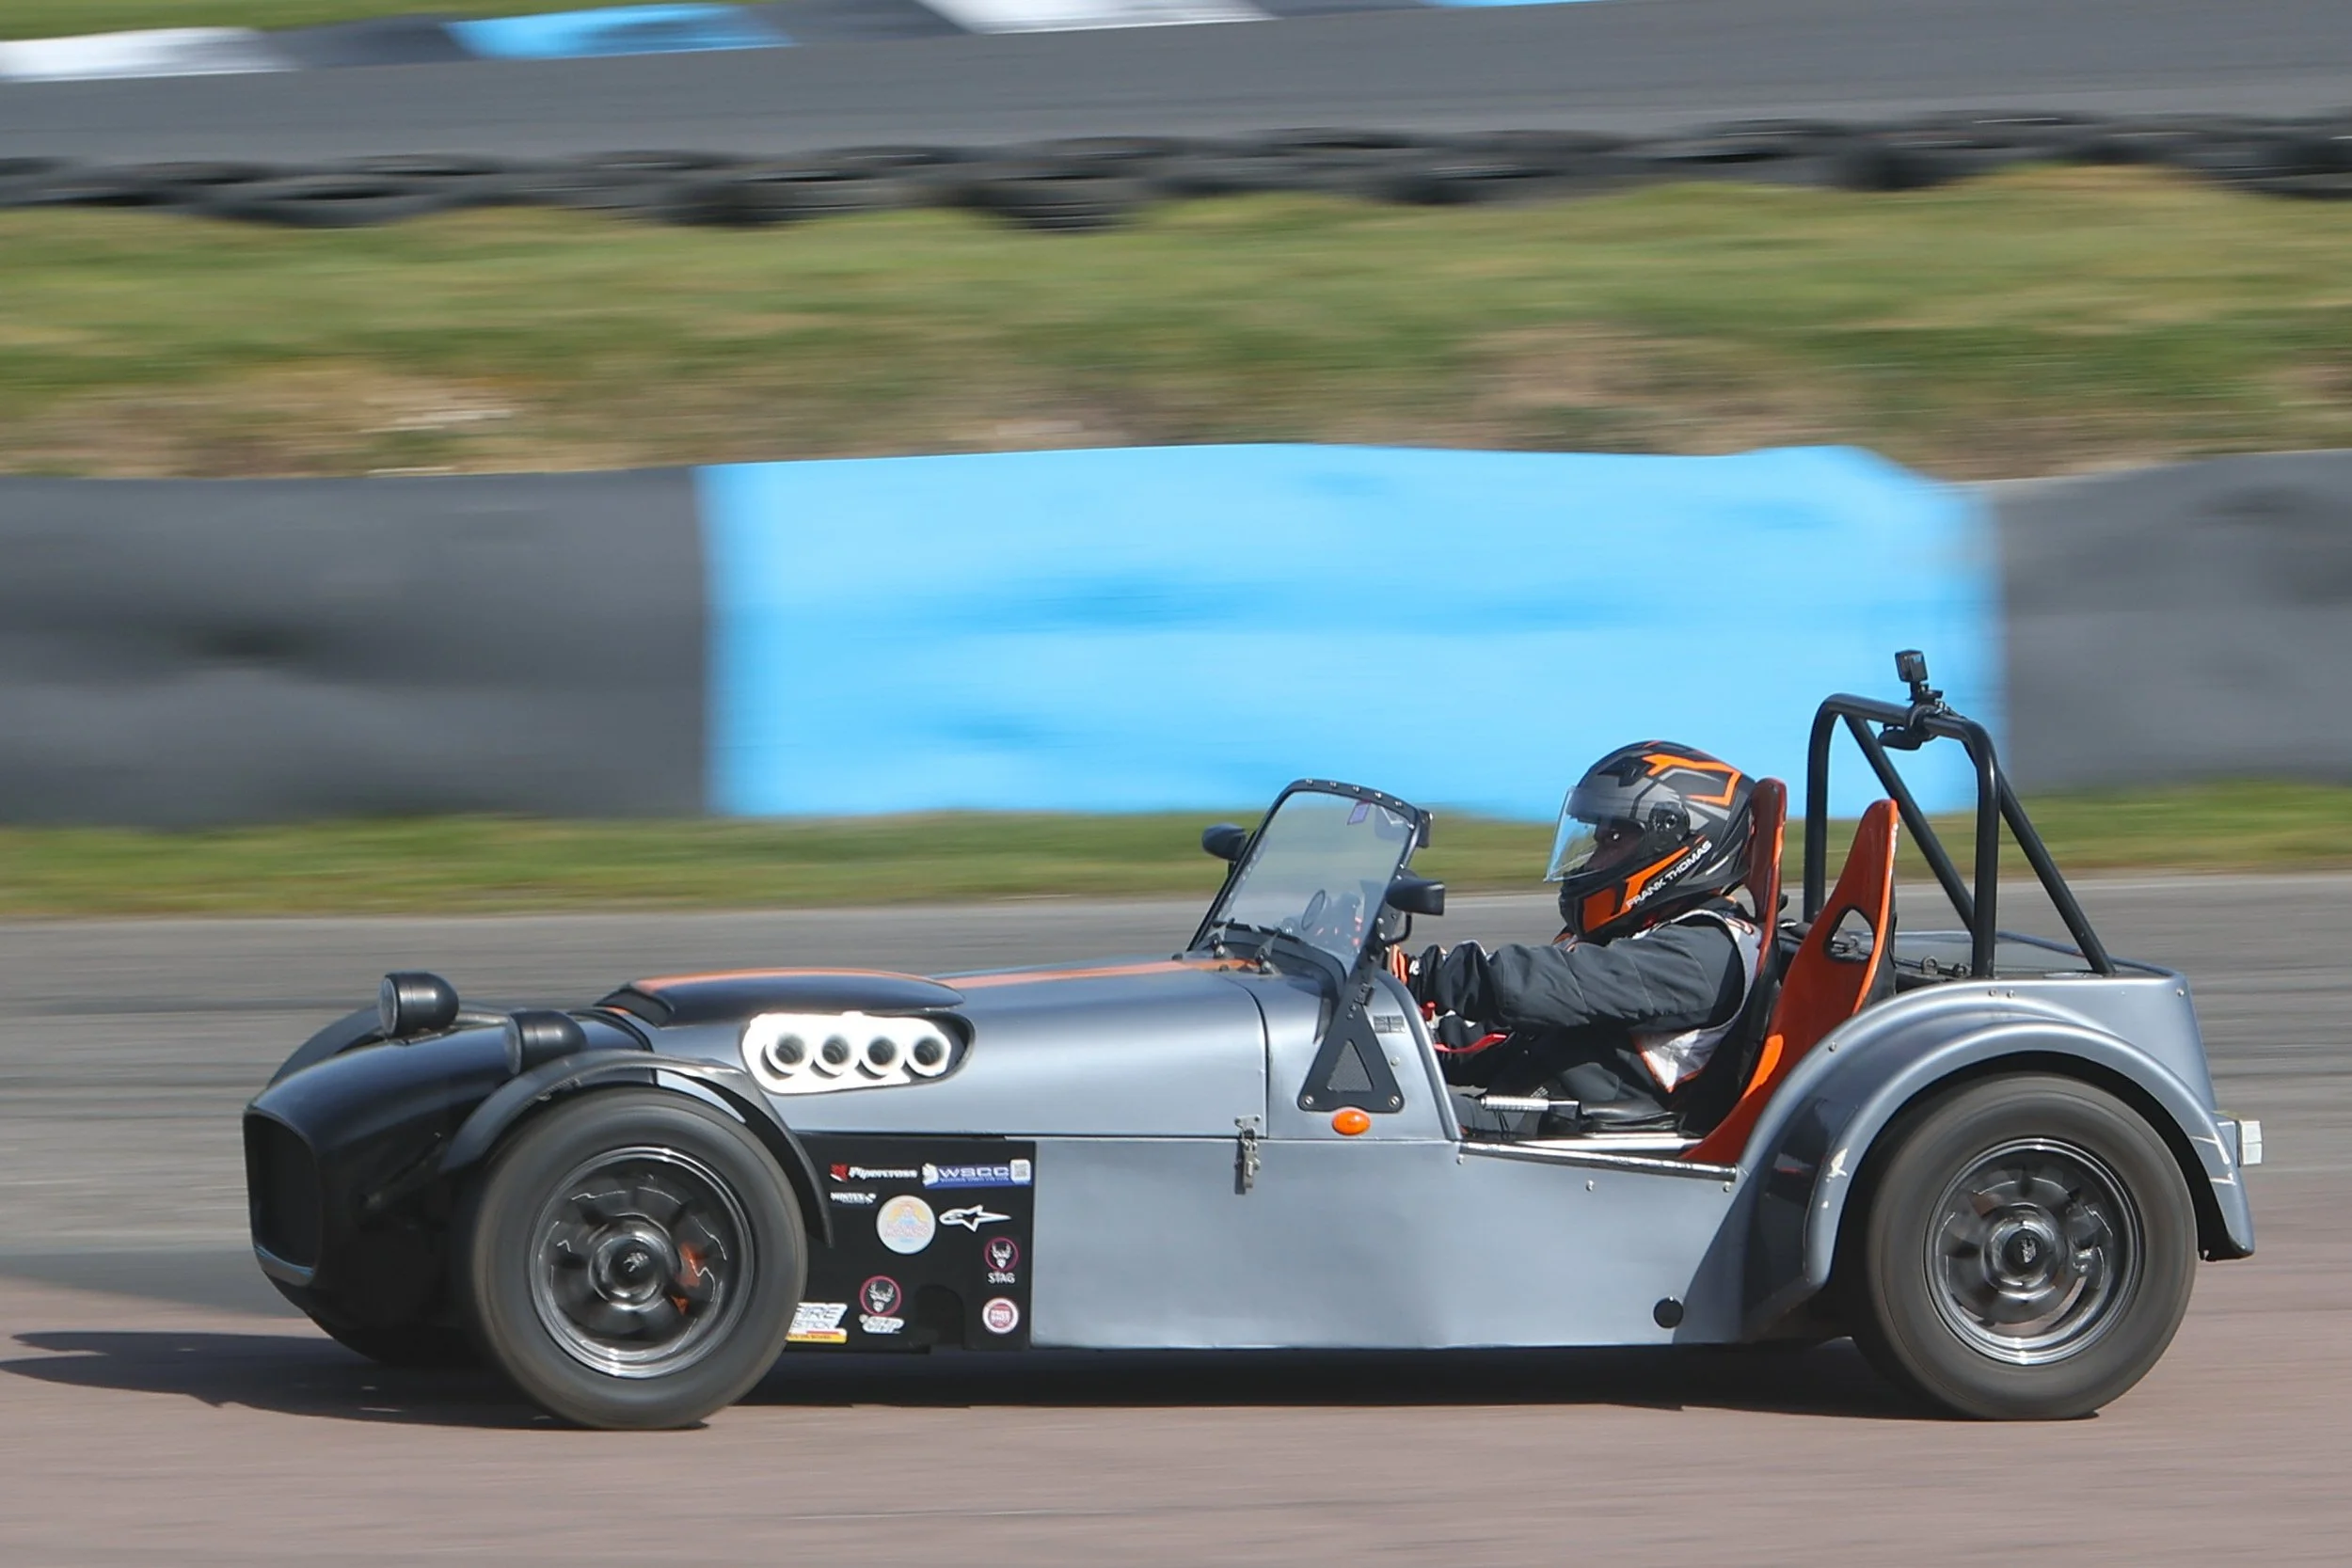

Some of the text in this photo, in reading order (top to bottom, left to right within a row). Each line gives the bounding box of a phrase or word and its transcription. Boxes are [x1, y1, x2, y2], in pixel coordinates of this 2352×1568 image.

[1626, 840, 1712, 910] FRANK THOMAS
[988, 1272, 1016, 1284] STAG
